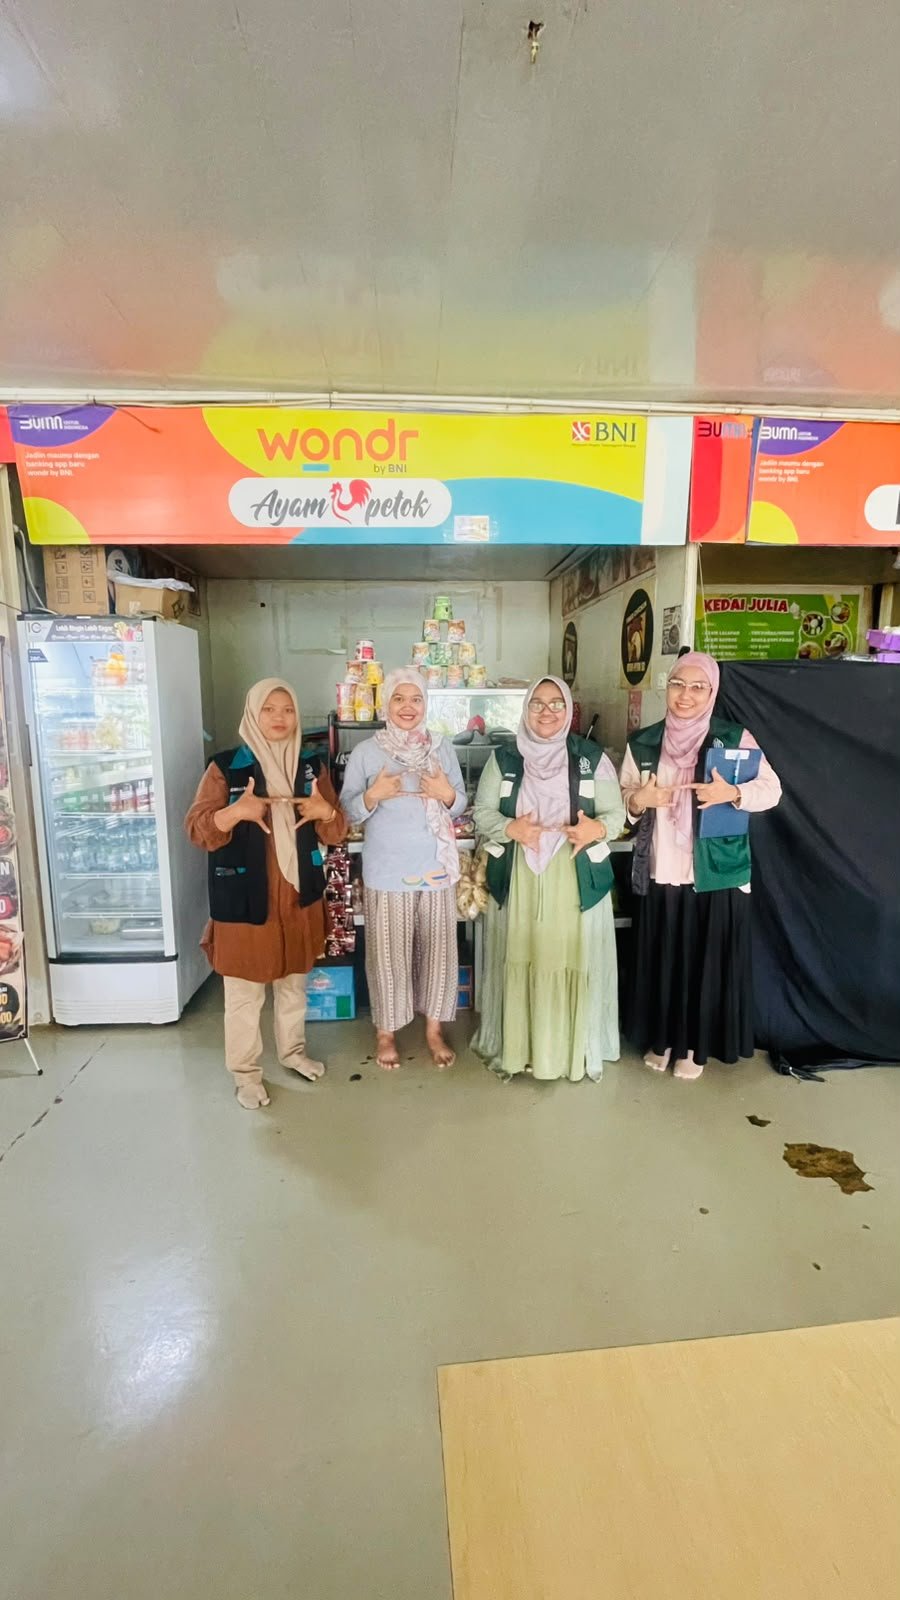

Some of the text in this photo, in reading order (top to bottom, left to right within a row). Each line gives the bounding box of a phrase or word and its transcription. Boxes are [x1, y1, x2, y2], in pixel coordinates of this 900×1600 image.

[256, 418, 419, 462] wondr
[595, 421, 637, 442] BNI
[374, 464, 407, 474] by BNI
[250, 489, 431, 526] Ayam petok
[704, 598, 789, 613] KEDAI JULIA
